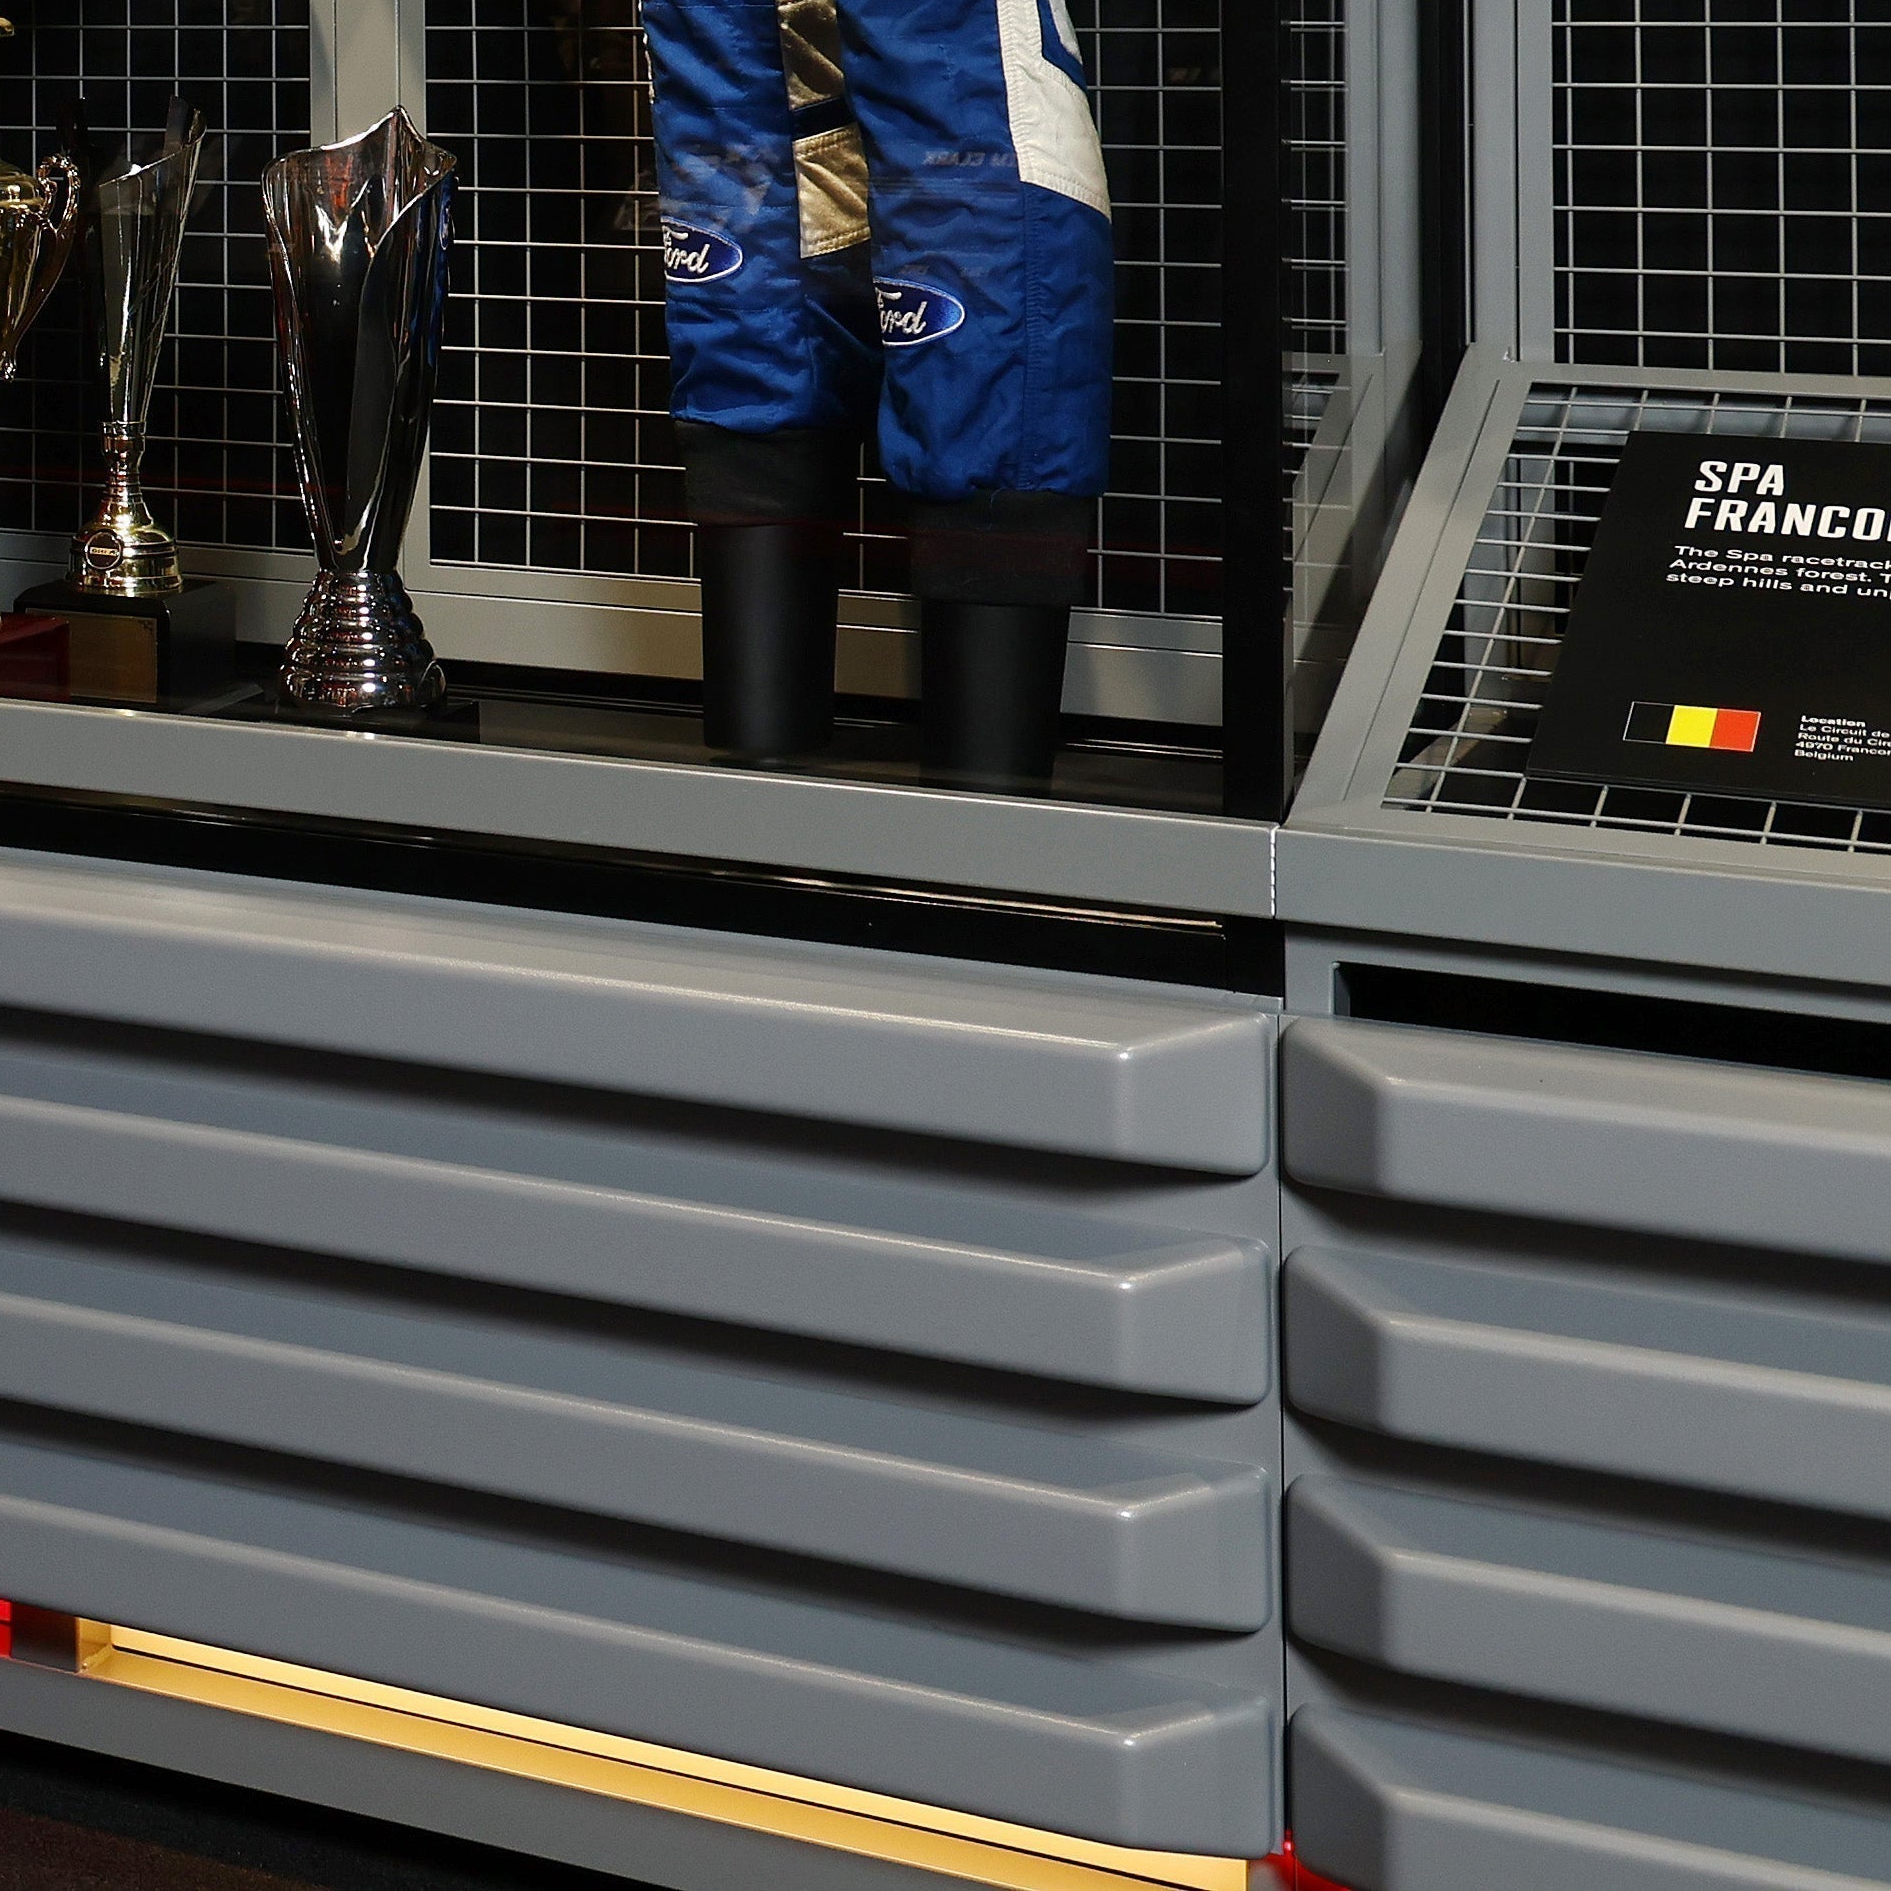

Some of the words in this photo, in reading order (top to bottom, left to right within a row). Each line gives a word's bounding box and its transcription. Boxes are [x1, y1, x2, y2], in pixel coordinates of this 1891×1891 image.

[1694, 460, 1784, 496] SPA
[1684, 497, 1891, 542] FRANCO
[1674, 545, 1719, 558] The
[1725, 549, 1774, 563] Spa
[1669, 559, 1788, 576] Ardennes
[1795, 567, 1872, 583] forest.
[1666, 572, 1734, 587] steep
[1742, 577, 1793, 591] hills
[1799, 583, 1848, 595] and
[1801, 715, 1866, 727] Location
[1797, 732, 1840, 742] Route
[1843, 737, 1863, 745] du
[1799, 724, 1817, 732] Le
[1820, 725, 1867, 736] Circuit
[1871, 730, 1890, 738] de
[1795, 741, 1834, 751] 4970
[1794, 749, 1854, 762] Belgium
